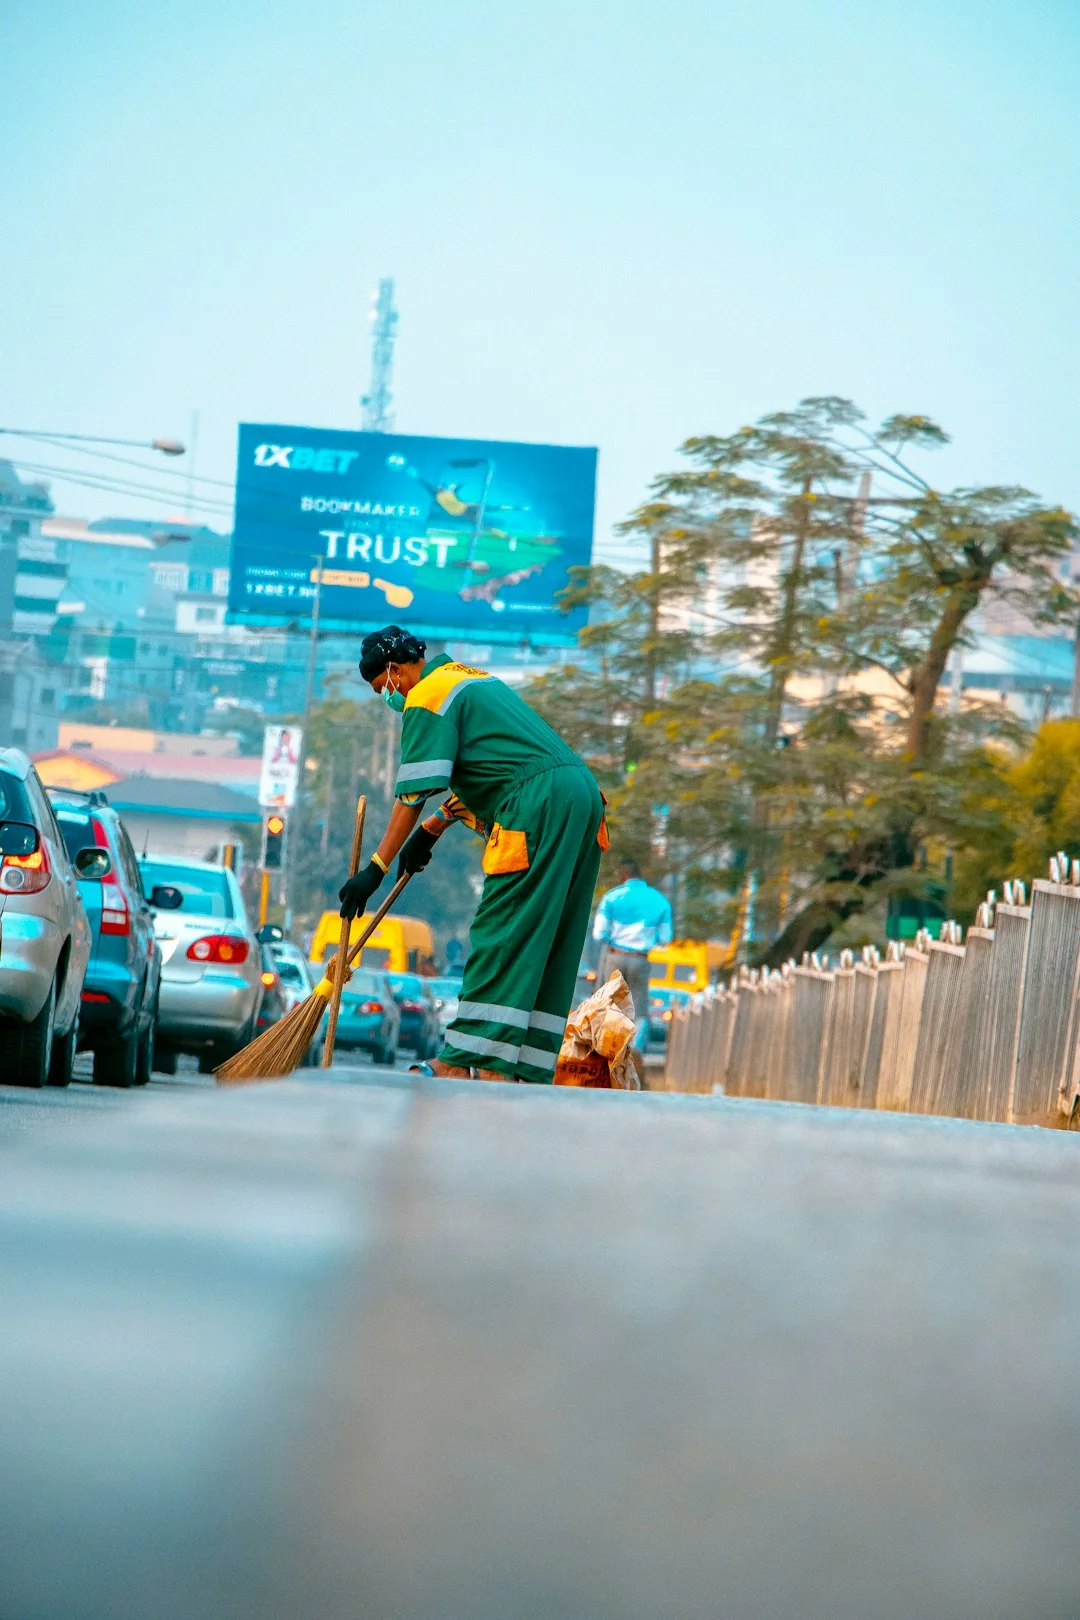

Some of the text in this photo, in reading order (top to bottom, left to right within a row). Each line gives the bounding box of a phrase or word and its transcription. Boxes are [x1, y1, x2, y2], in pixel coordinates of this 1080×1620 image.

[254, 444, 359, 474] 1XBET
[301, 496, 419, 516] BOOKMAKER
[319, 529, 457, 568] TRUST
